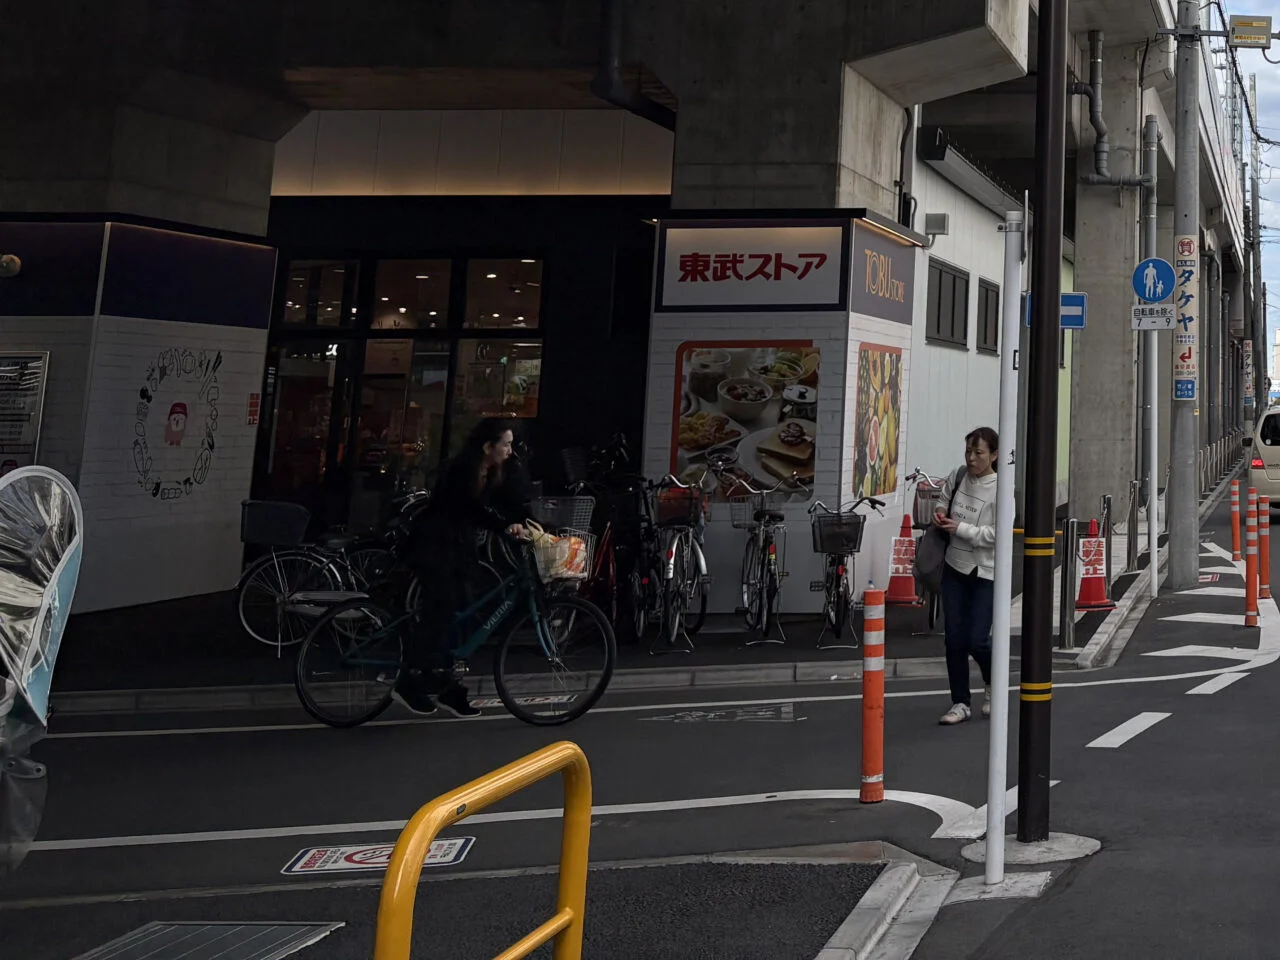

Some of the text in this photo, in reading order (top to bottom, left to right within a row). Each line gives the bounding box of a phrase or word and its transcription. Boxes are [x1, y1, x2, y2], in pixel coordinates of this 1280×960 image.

[678, 252, 828, 283] 東武ストア
[865, 248, 892, 299] TOBU
[1134, 307, 1173, 317] 自転車を除く
[1178, 268, 1195, 333] タケヤ
